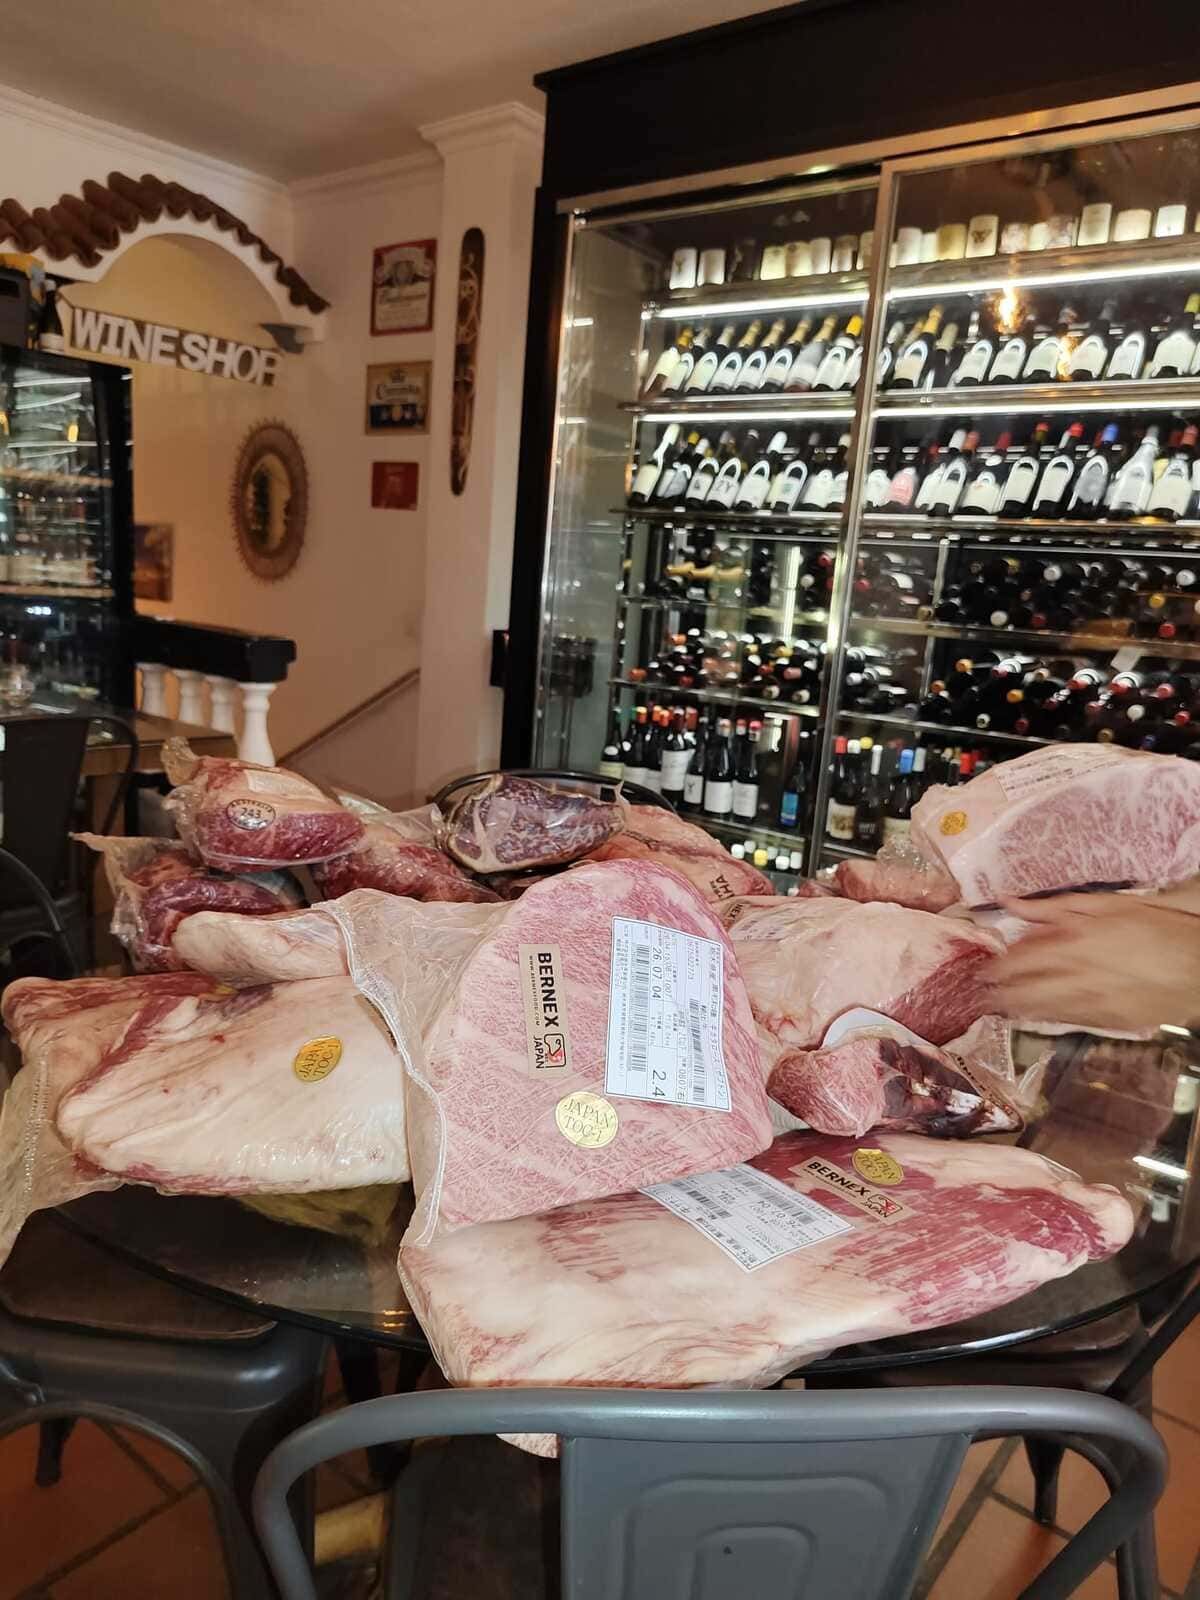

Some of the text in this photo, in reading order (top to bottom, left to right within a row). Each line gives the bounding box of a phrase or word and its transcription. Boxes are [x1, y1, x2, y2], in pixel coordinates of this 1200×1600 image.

[73, 308, 284, 388] WINE SHOP
[537, 952, 560, 1028] BERNEX
[533, 1035, 545, 1070] JAPAN
[651, 1069, 665, 1098] 2.4
[808, 1161, 871, 1196] BERNEX
